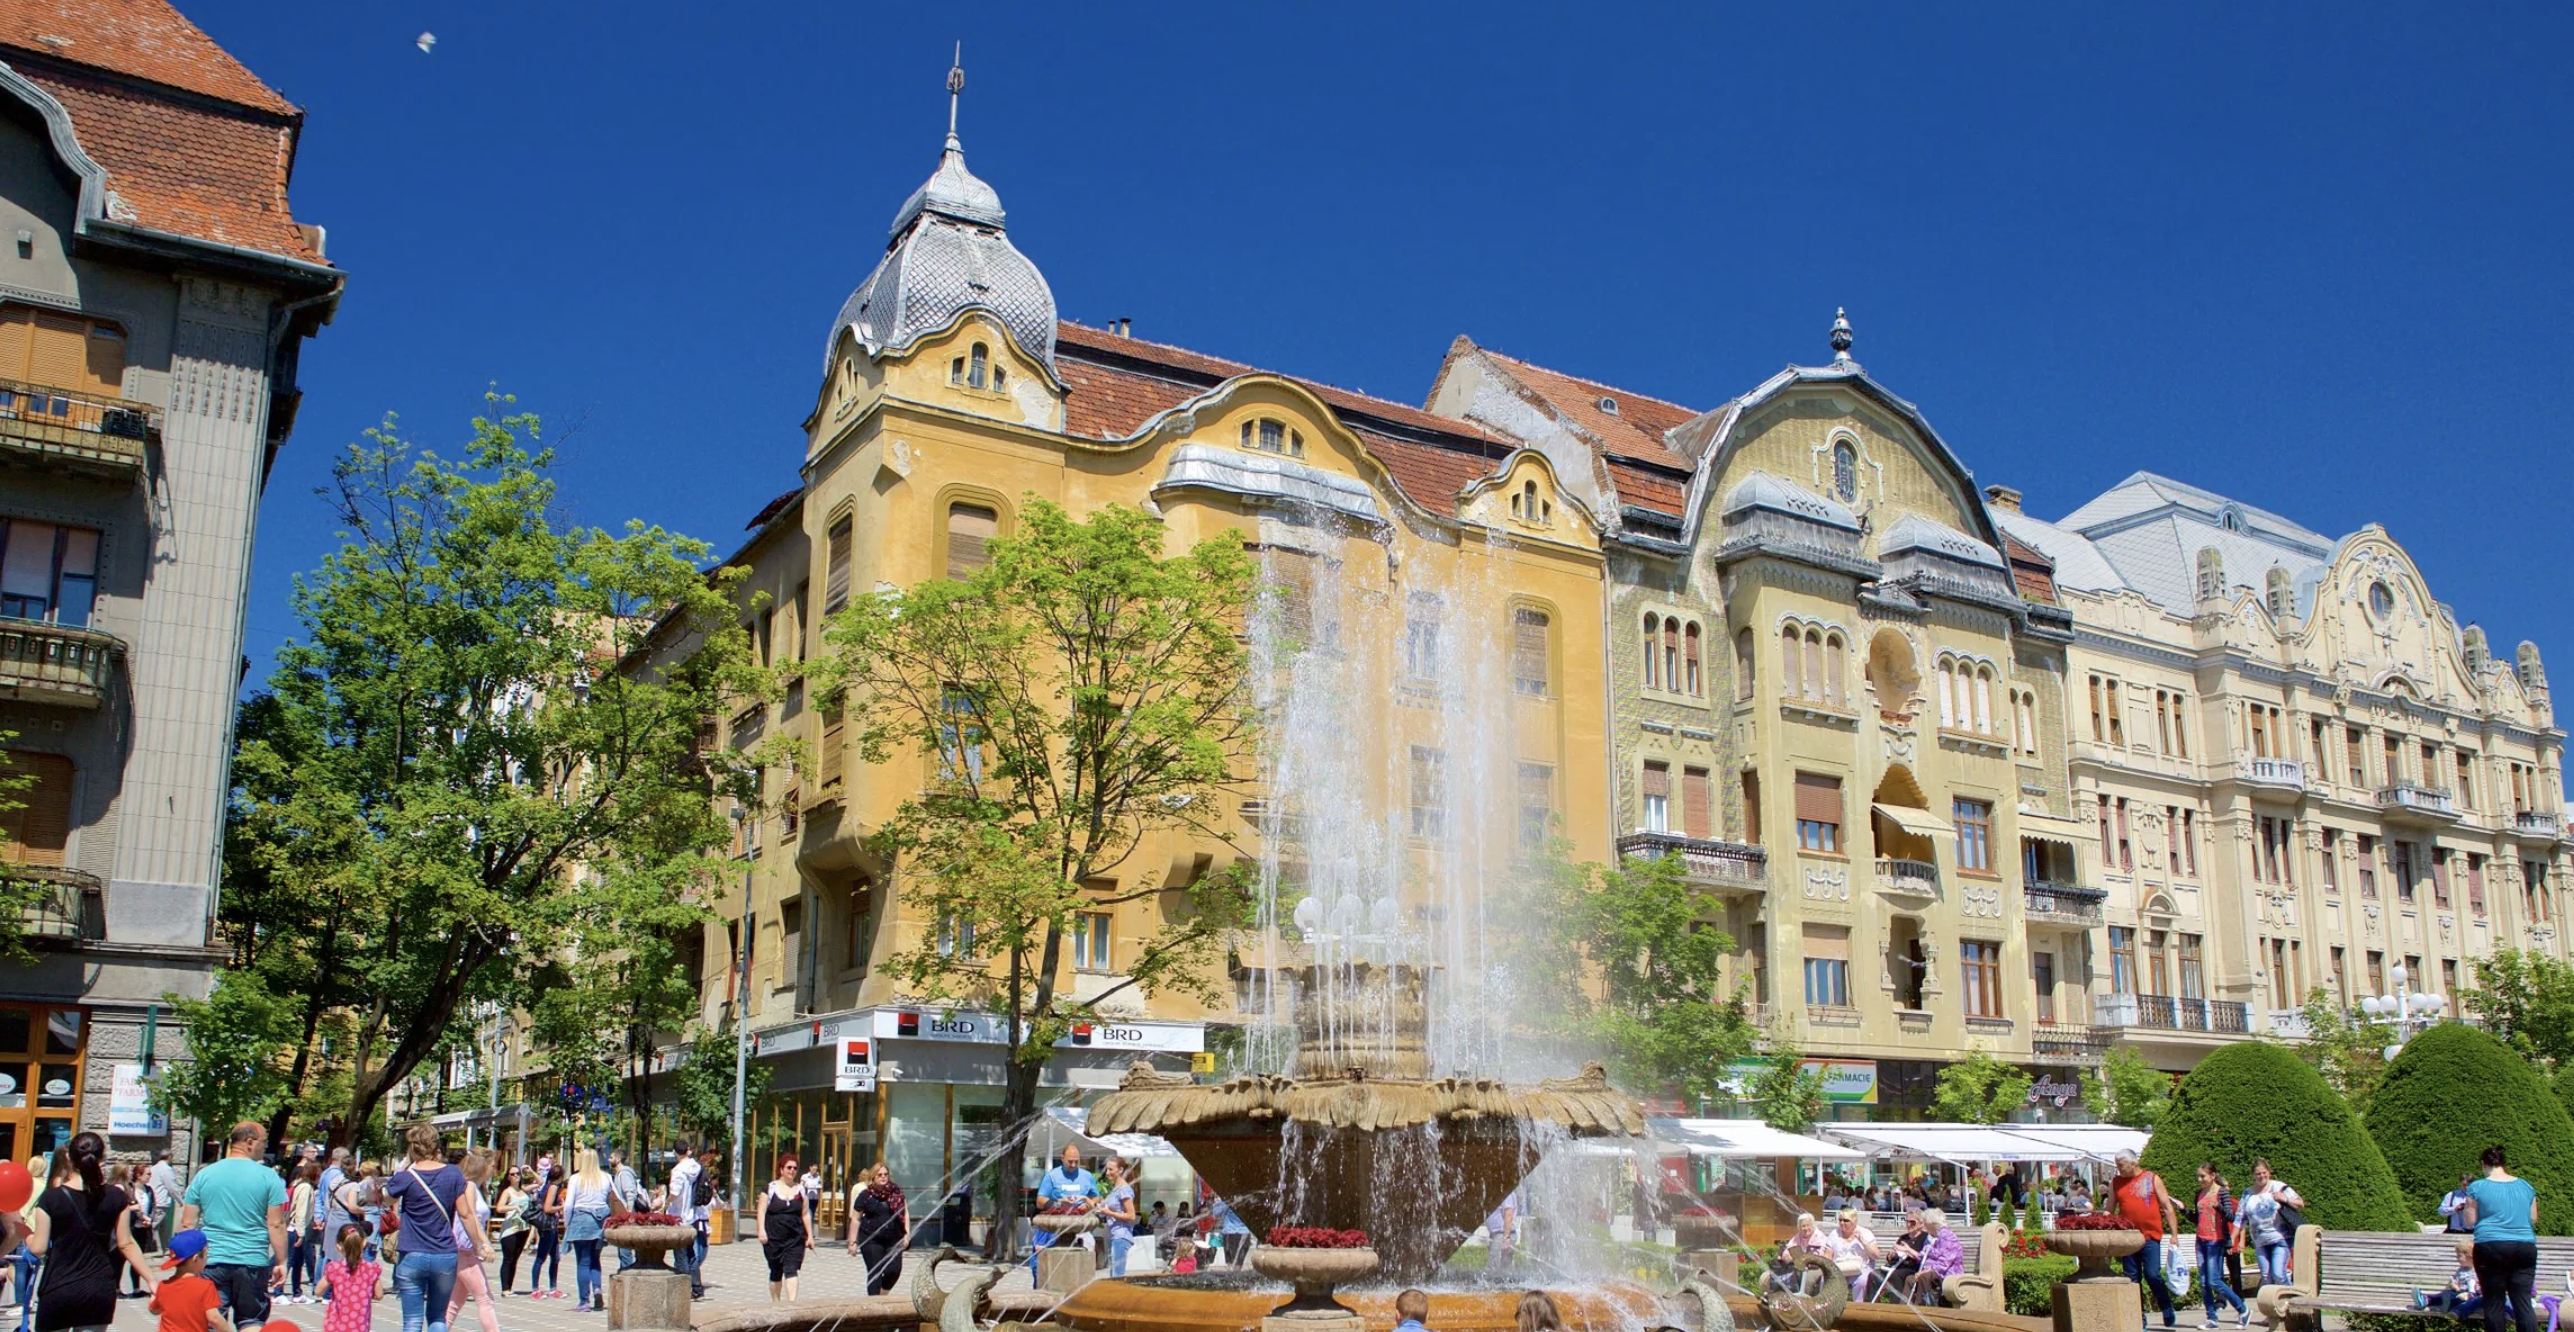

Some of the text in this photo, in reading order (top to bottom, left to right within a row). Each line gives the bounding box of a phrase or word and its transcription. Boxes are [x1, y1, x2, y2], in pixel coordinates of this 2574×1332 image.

[823, 1024, 840, 1037] BRD
[931, 1020, 975, 1034] BRD
[1103, 1028, 1143, 1041] BRD
[761, 1035, 776, 1048] BRD
[844, 1066, 870, 1074] BRD
[1827, 1072, 1871, 1083] FARMACIE
